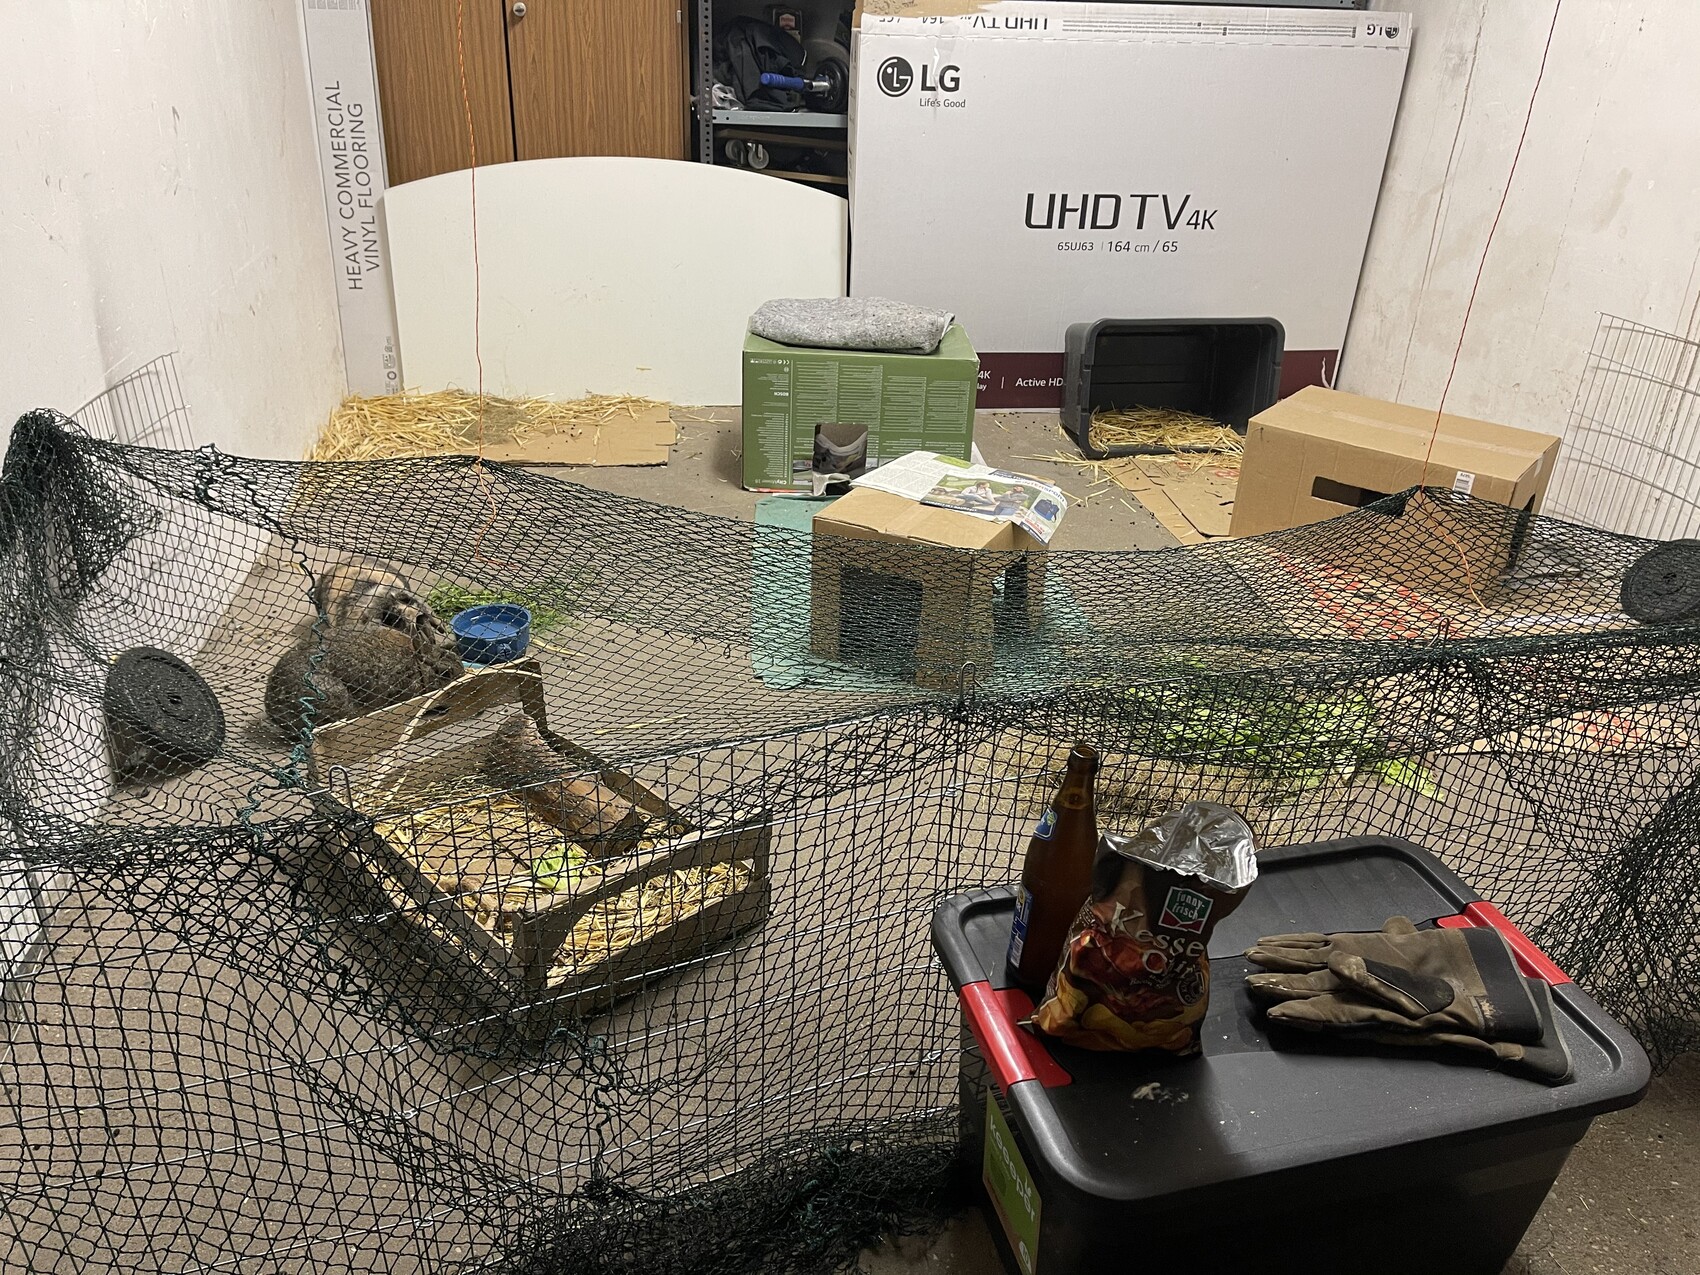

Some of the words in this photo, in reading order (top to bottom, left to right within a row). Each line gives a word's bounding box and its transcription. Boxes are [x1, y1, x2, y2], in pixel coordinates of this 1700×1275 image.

[921, 64, 961, 92] LG
[919, 98, 941, 107] Life's
[943, 98, 966, 108] Good
[325, 80, 355, 220] COMMERCIAL
[347, 102, 374, 208] FLOORING
[1025, 193, 1122, 230] UHD
[344, 226, 364, 290] HEAVY
[361, 215, 380, 272] VINYL
[1057, 241, 1094, 251] 65UJ63
[1107, 240, 1131, 252] 164
[1134, 243, 1150, 252] cm
[1162, 240, 1178, 252] 65
[1015, 377, 1047, 387] Active
[1172, 902, 1199, 920] frisch
